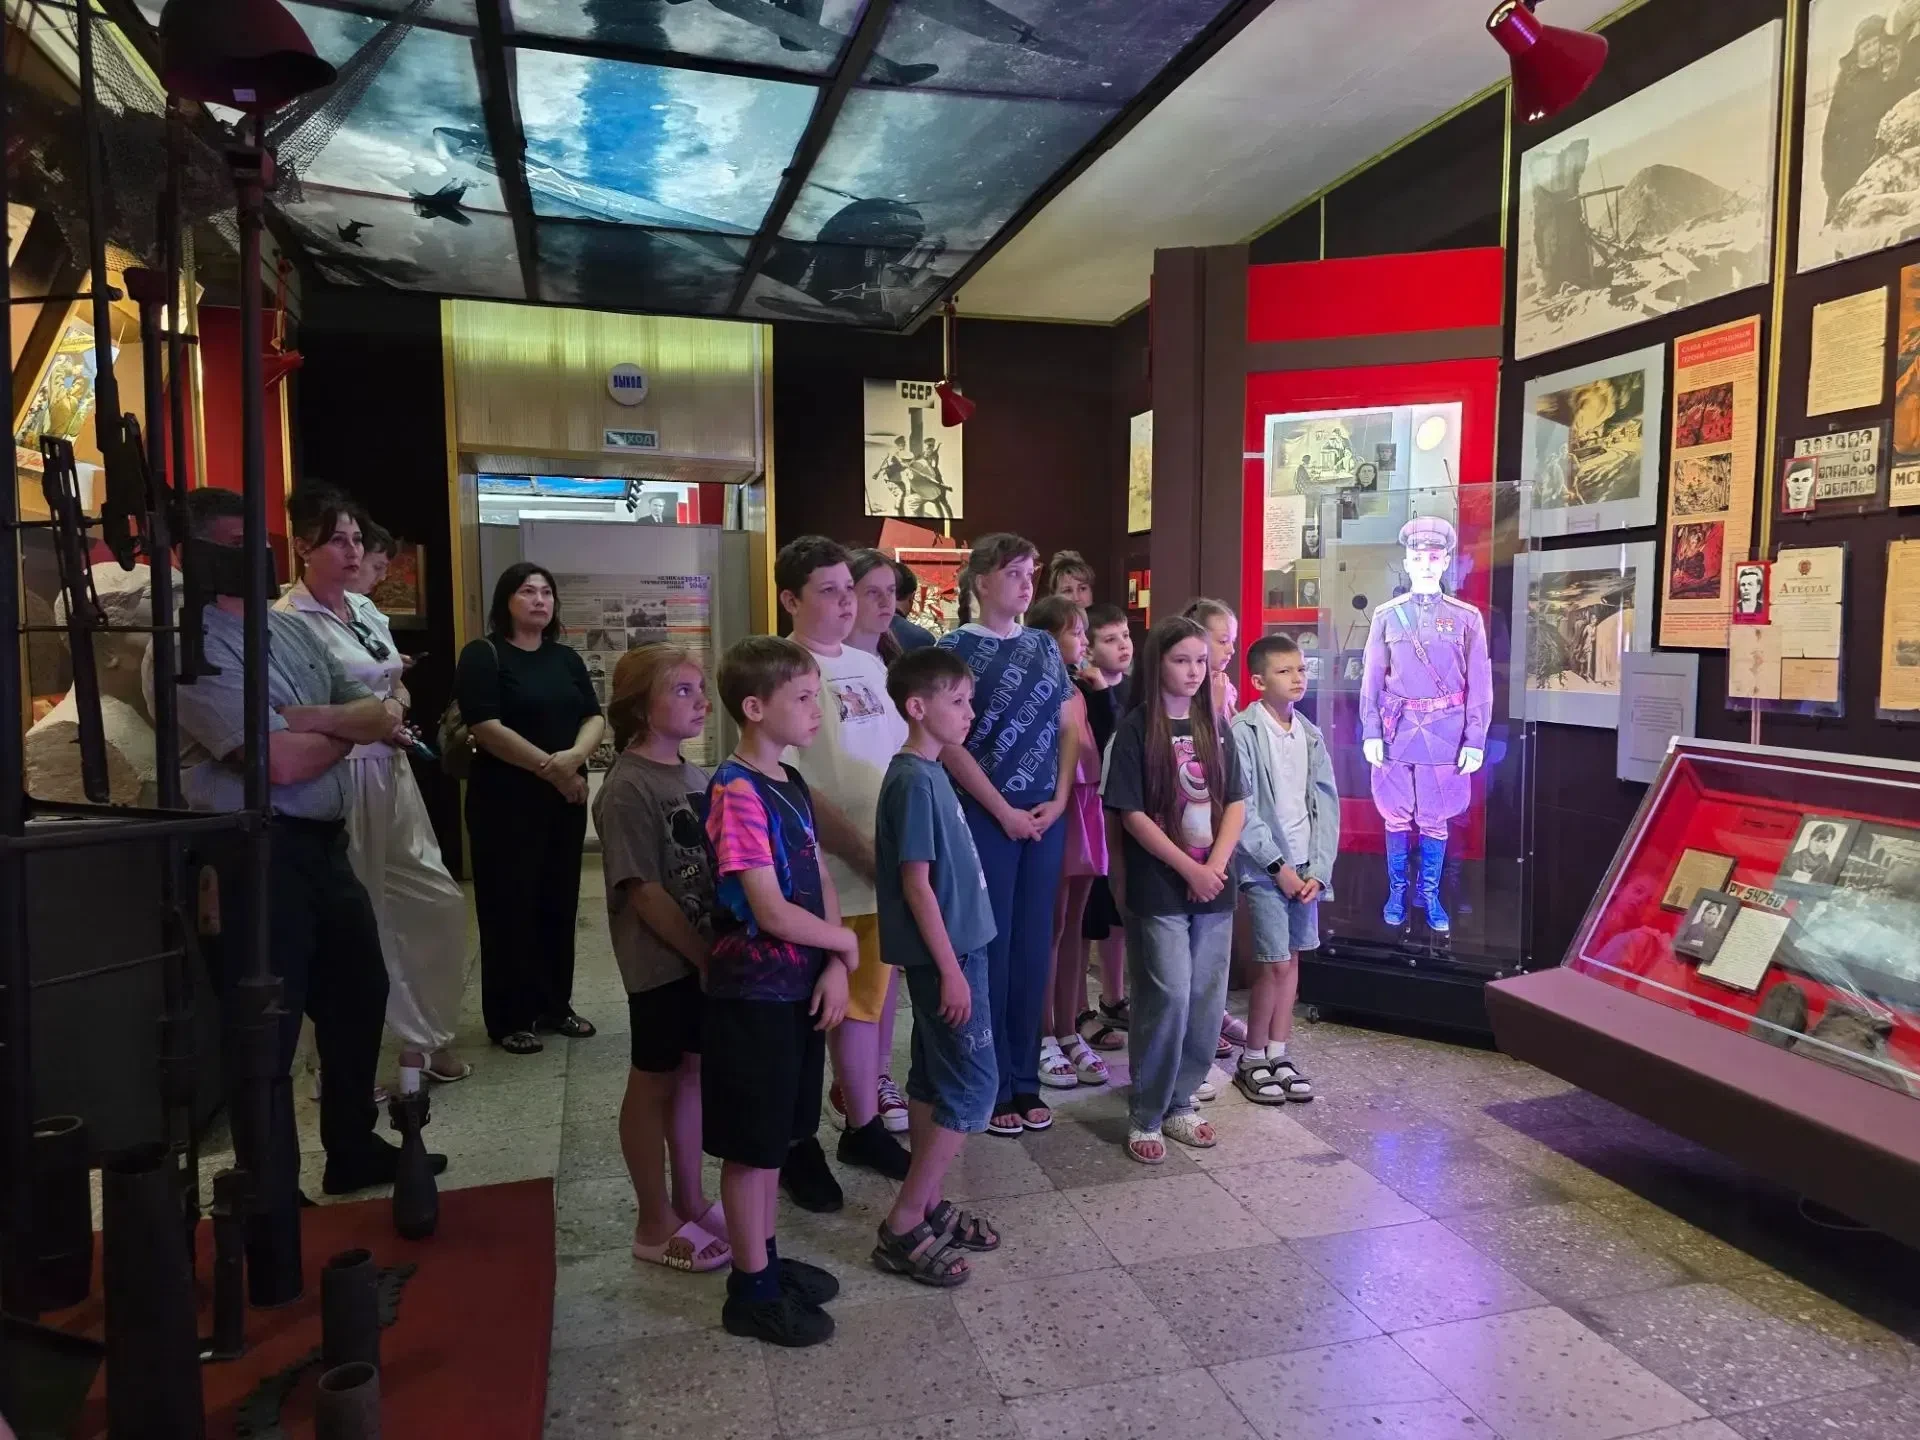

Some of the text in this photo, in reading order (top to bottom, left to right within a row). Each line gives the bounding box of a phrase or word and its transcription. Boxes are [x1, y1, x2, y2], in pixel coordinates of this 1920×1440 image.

[613, 375, 642, 388] ВЫХОД
[901, 382, 932, 400] СССР
[608, 432, 653, 446] ХОД
